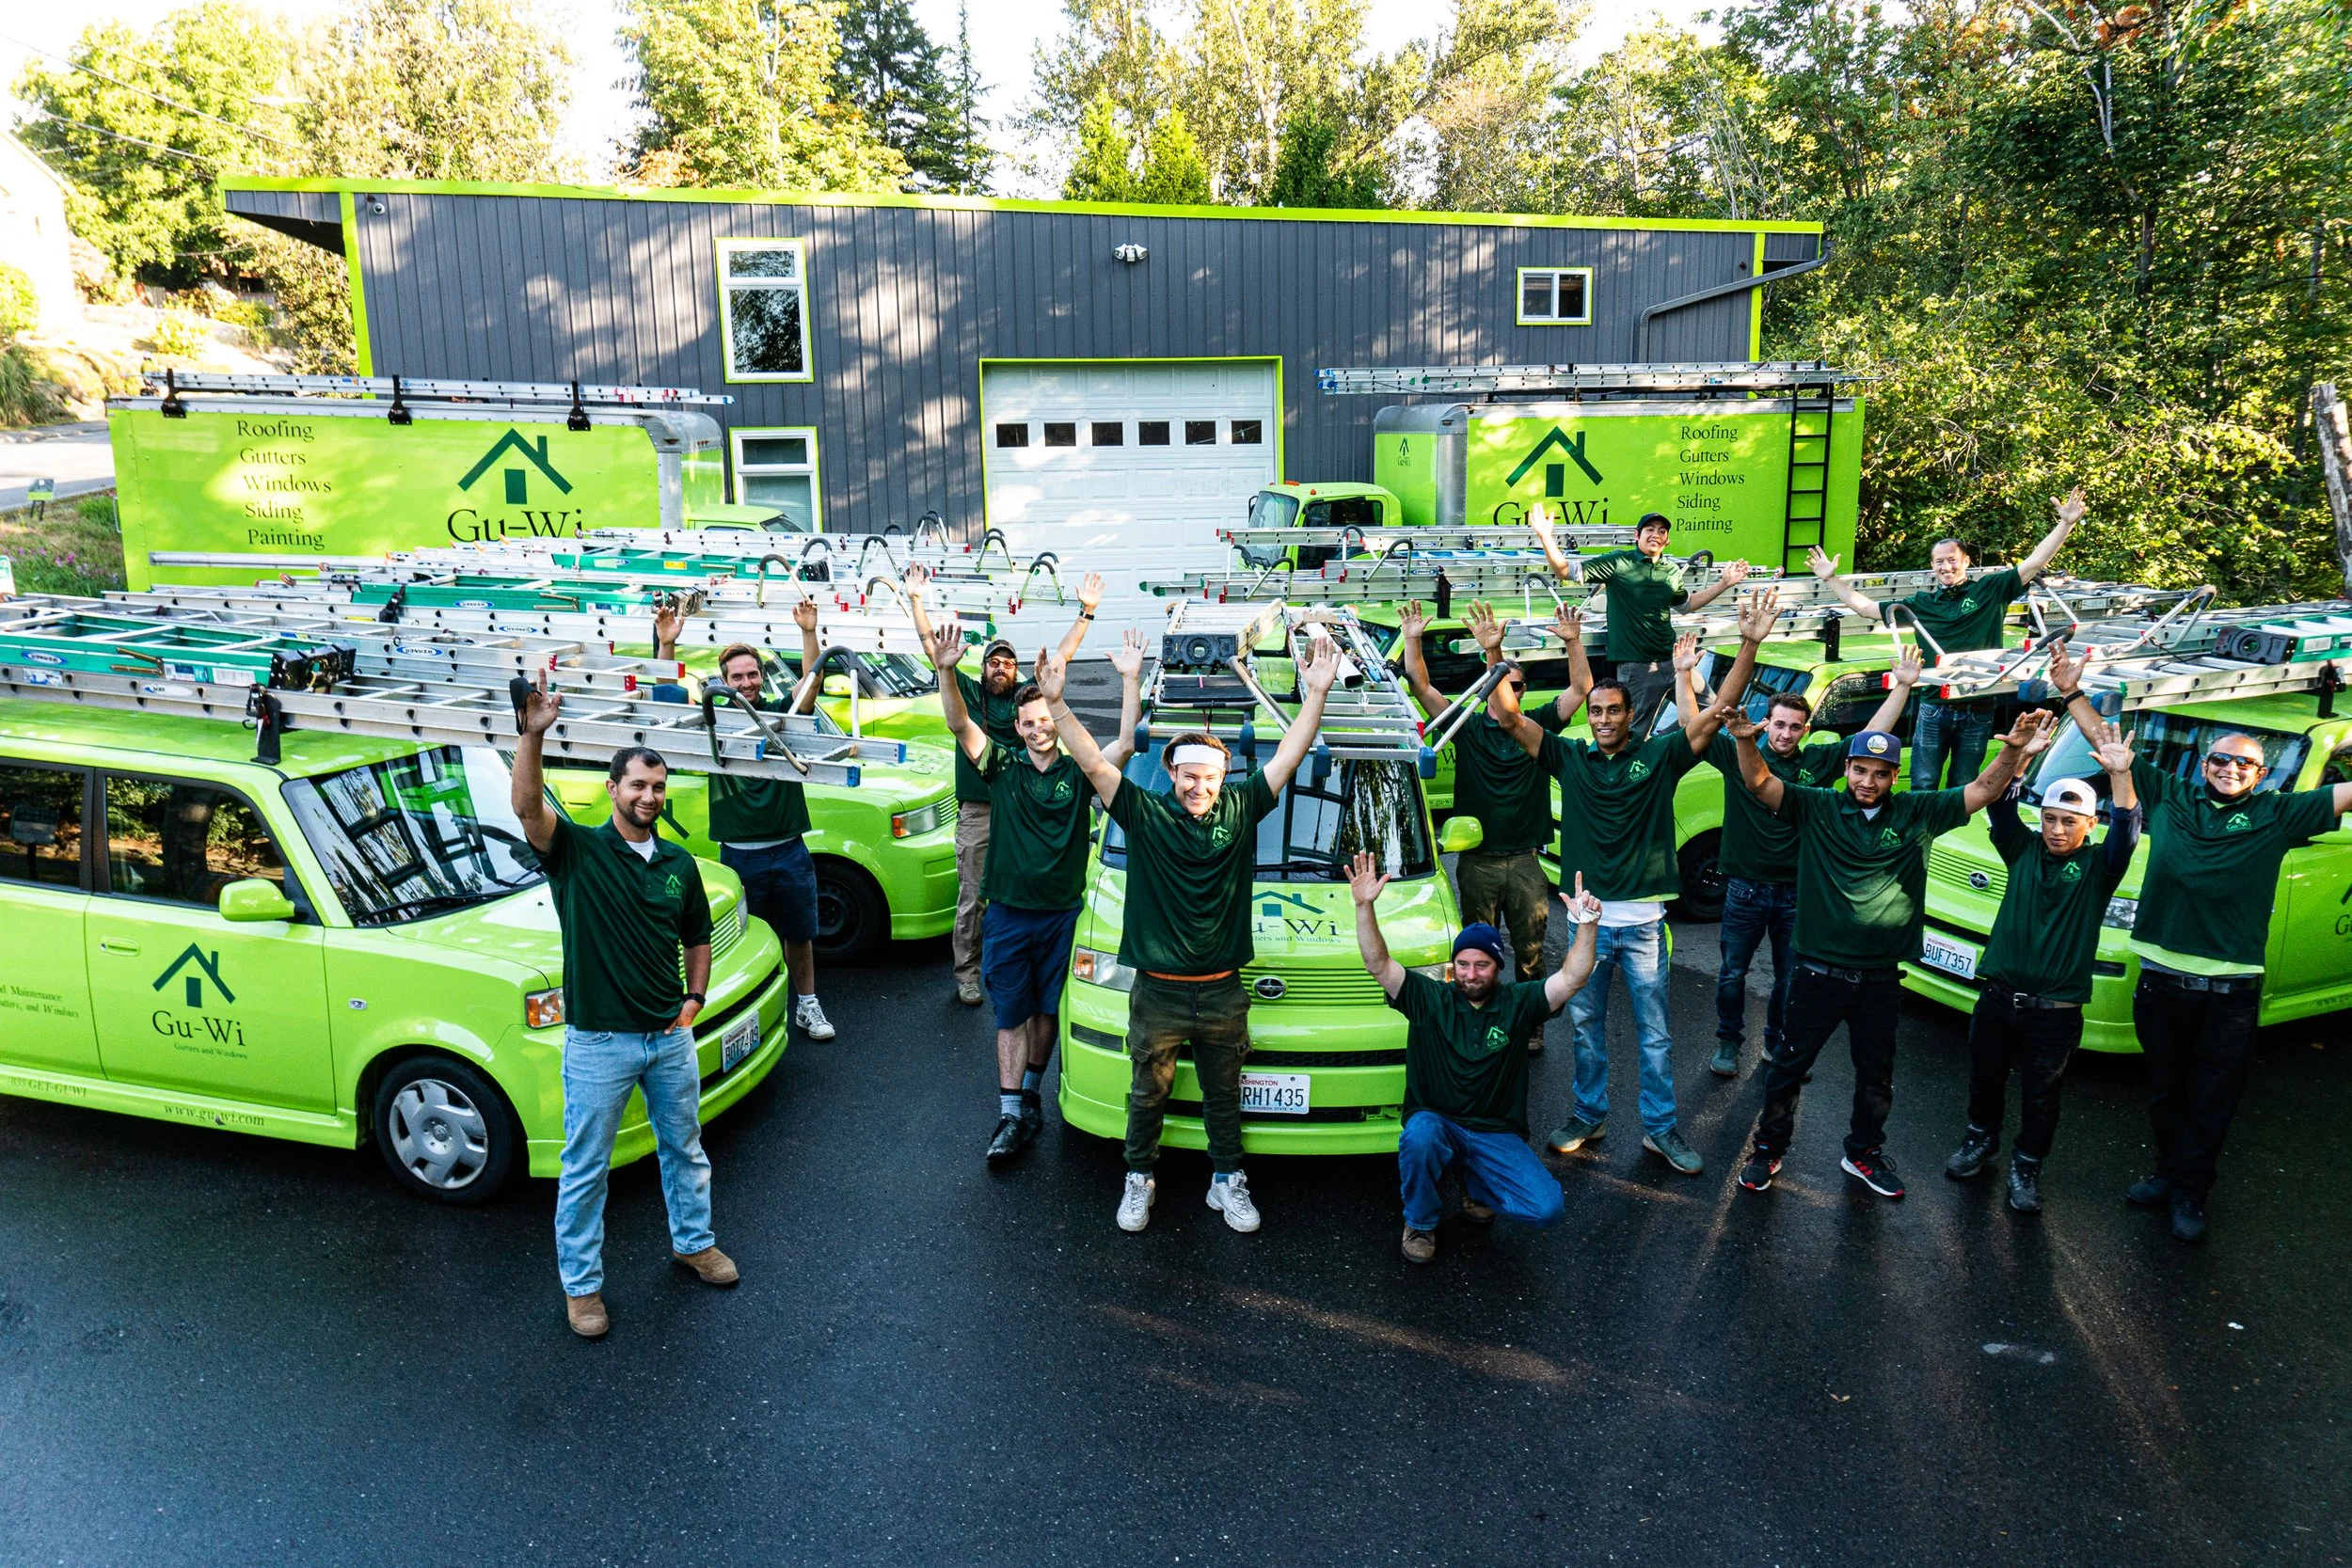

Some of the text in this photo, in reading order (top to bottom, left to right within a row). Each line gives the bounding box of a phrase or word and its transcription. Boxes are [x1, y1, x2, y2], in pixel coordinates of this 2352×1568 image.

[237, 420, 314, 443] Roofing
[1681, 425, 1738, 443] Roofing
[240, 448, 306, 465] Gutters
[1679, 449, 1729, 463] Gutters
[244, 474, 332, 493] Windows
[1679, 469, 1745, 485] Windows
[245, 500, 304, 524] Siding
[1677, 493, 1721, 512] Siding
[1676, 516, 1733, 534] Painting
[248, 529, 326, 551] Painting
[1252, 918, 1341, 937] u-Wi
[1925, 943, 1973, 973] BUF7357
[10, 985, 63, 1002] Maintenance
[152, 1010, 246, 1046] Gu-Wi
[1242, 1086, 1305, 1107] RH1435
